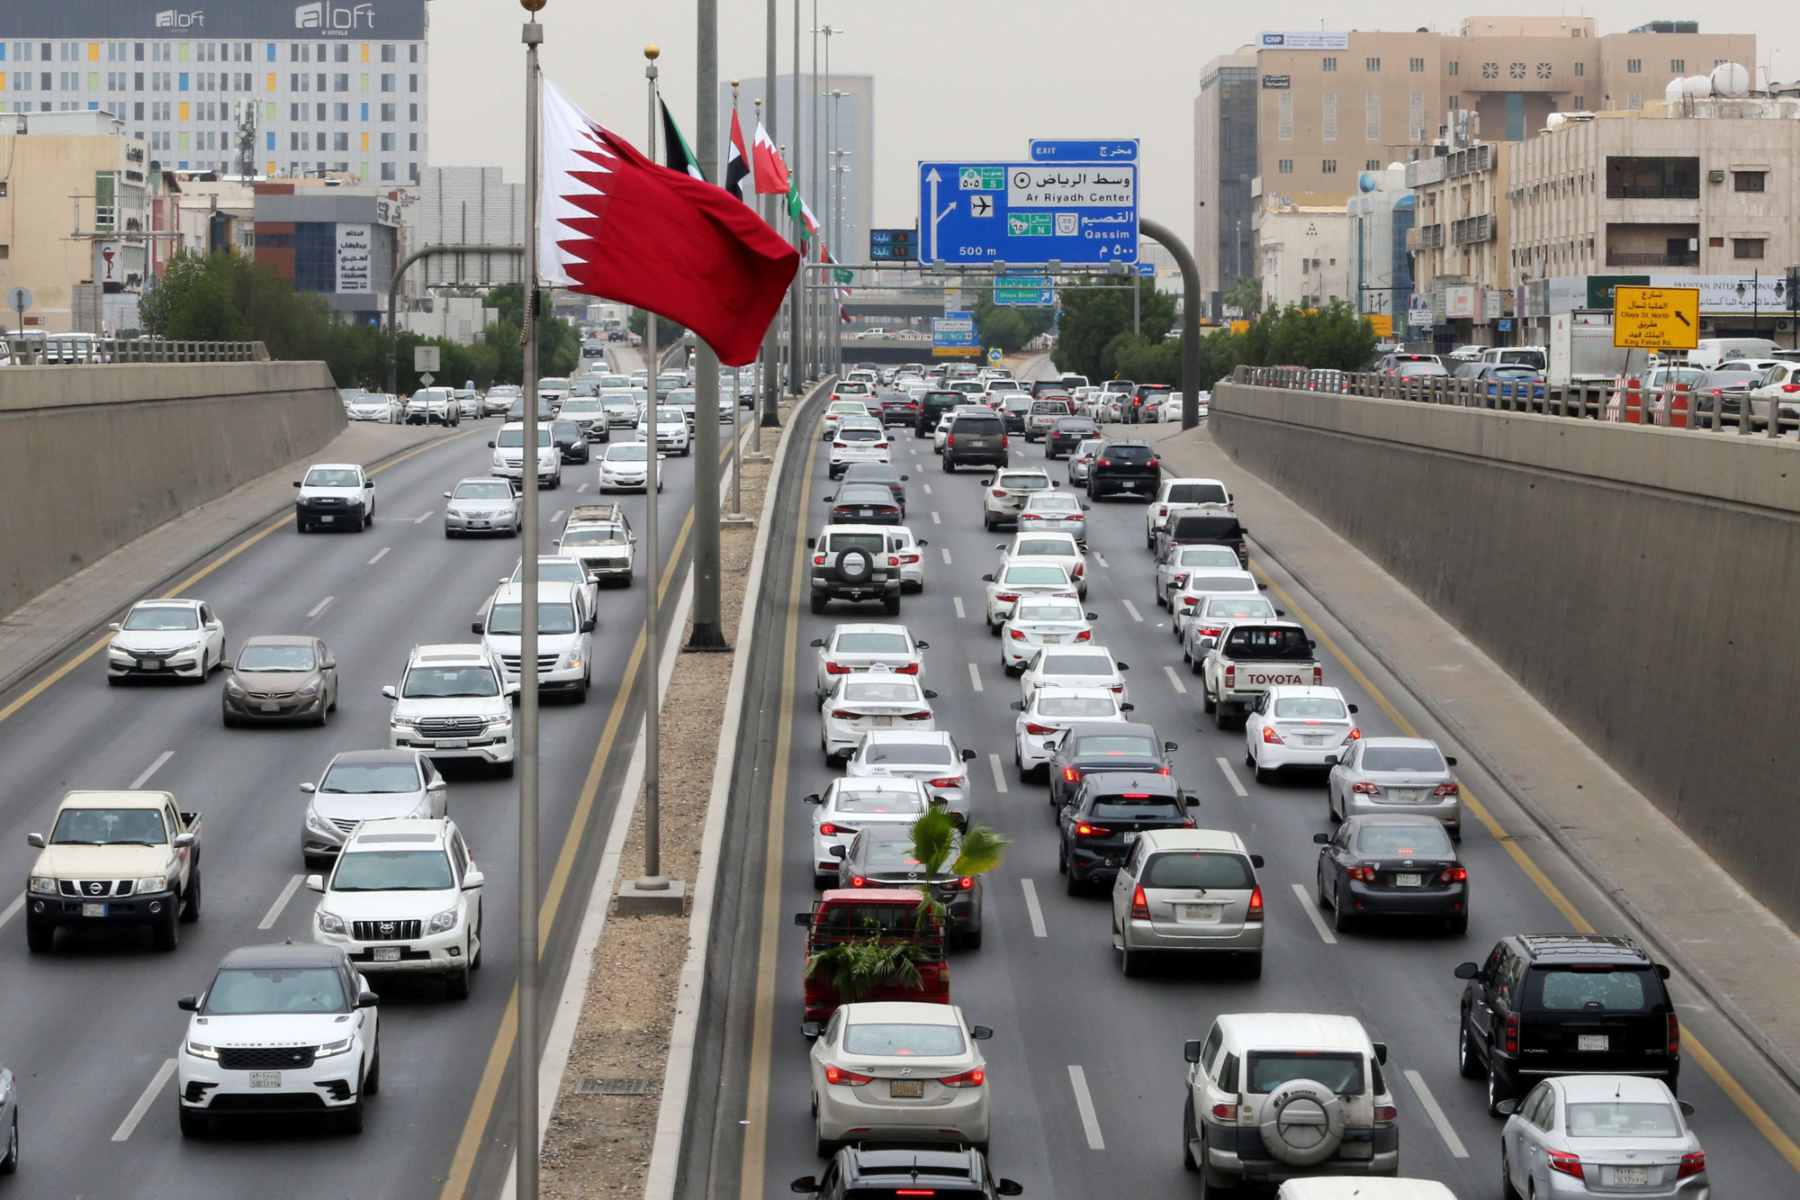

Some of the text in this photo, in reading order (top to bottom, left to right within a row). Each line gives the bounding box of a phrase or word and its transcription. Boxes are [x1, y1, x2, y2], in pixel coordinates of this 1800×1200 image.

[156, 9, 206, 28] aloft
[296, 0, 376, 29] aloft
[1036, 146, 1057, 155] EXIT
[1099, 145, 1132, 157] مخرج
[1036, 172, 1130, 189] وسط الرياض
[1026, 192, 1131, 203] Ar Riyadh Center
[1081, 211, 1134, 228] القصيم
[1084, 230, 1130, 239] Qassim
[960, 246, 997, 256] 500 m
[1100, 244, 1134, 258] ٥٠٠ م
[1641, 290, 1664, 301] شارع
[1627, 301, 1648, 310] شمال
[1637, 321, 1659, 329] طريق
[1248, 674, 1302, 685] TOYOTA
